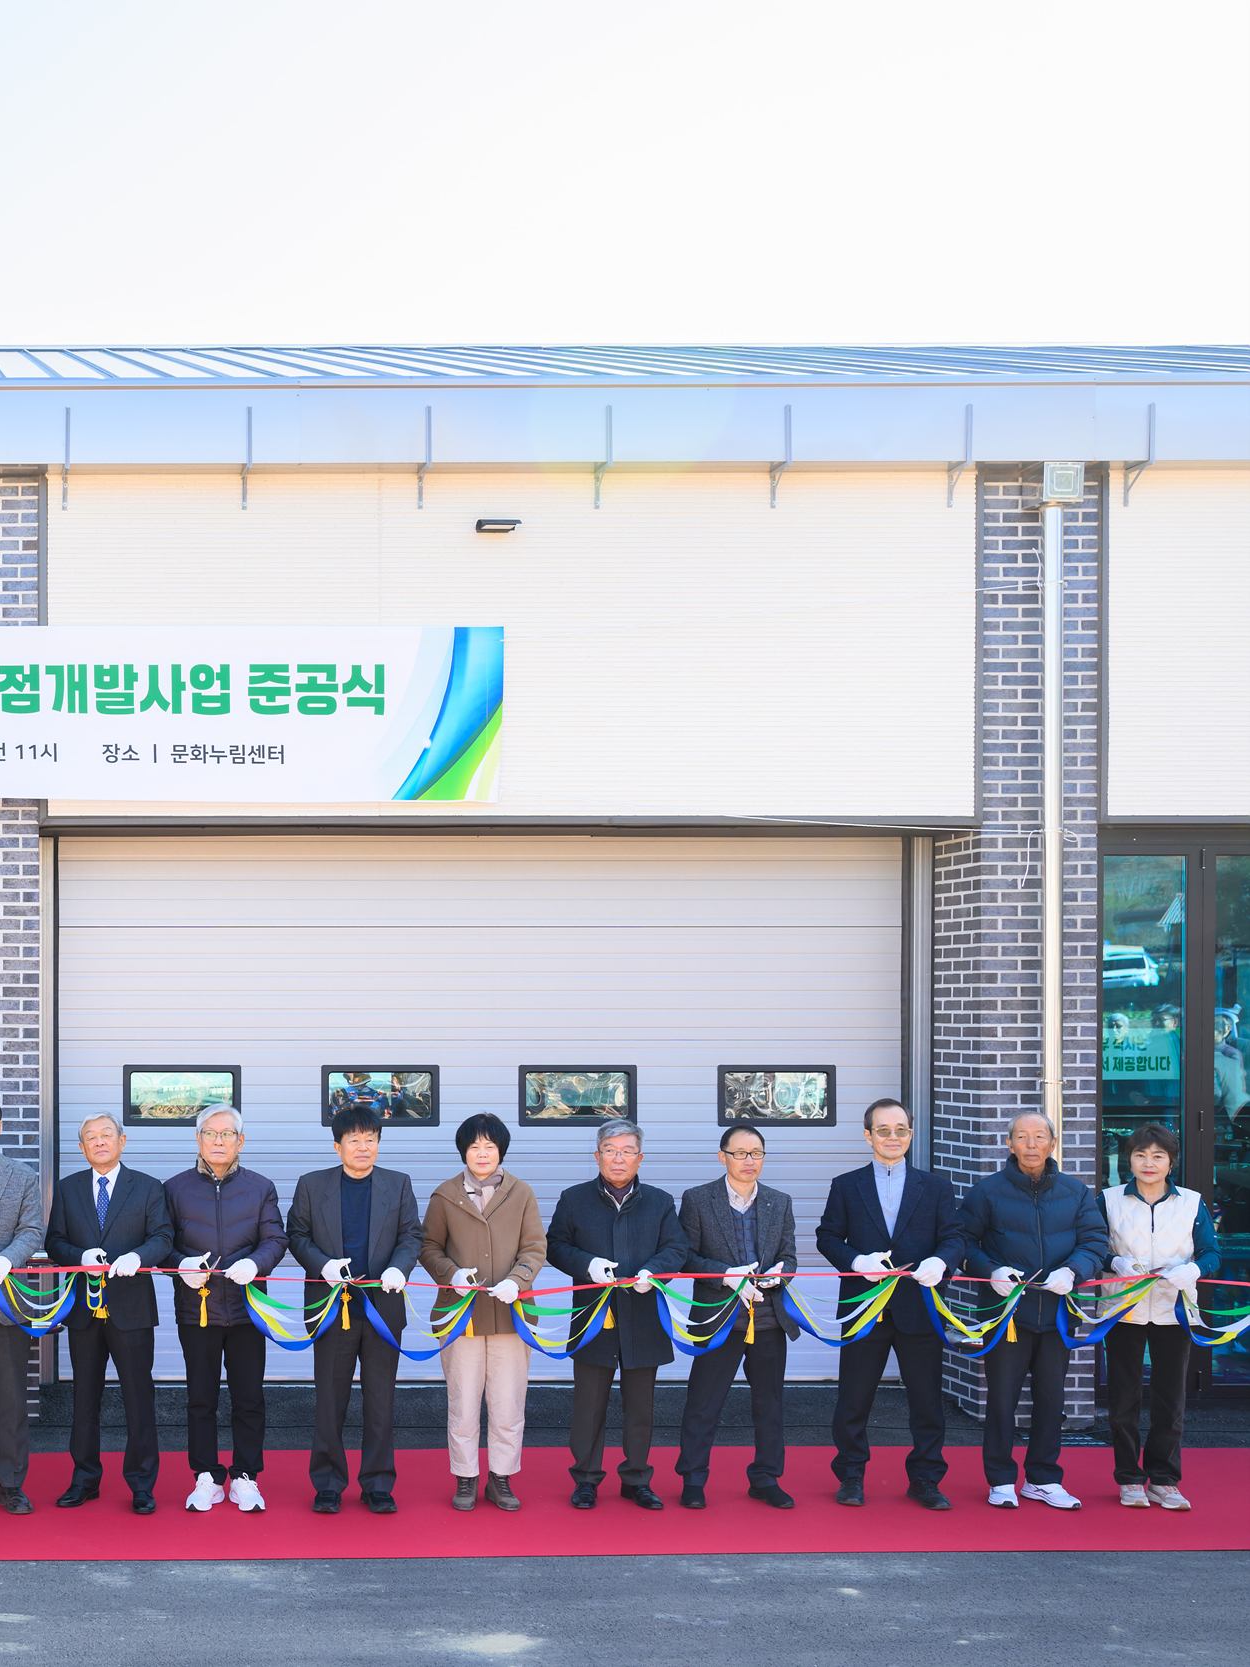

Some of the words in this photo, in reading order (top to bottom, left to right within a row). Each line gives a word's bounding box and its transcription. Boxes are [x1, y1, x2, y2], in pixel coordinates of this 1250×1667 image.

[247, 663, 386, 716] 준공식
[14, 742, 58, 763] 11시
[102, 743, 141, 764] 장소
[170, 743, 285, 765] 문화누림센터
[1112, 1055, 1171, 1072] 제공합니다
